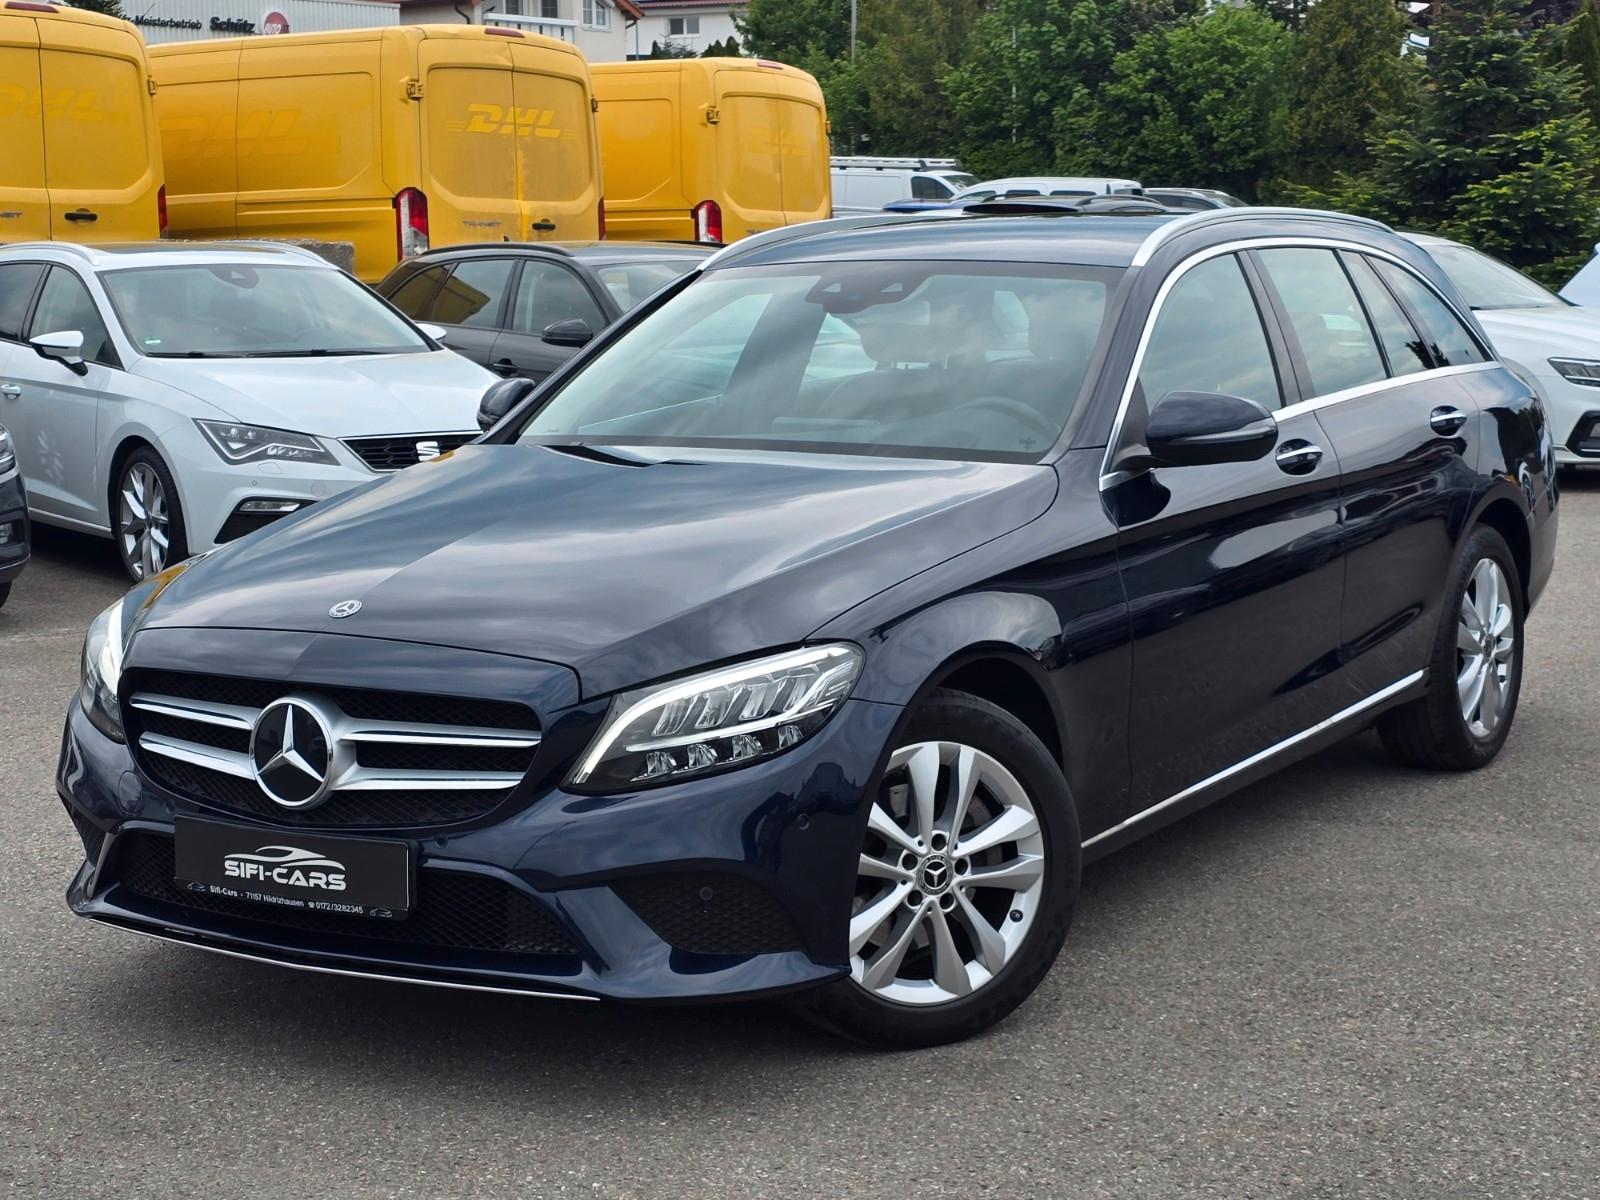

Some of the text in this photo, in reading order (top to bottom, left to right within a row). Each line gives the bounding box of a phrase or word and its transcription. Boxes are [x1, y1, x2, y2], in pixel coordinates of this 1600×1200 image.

[466, 103, 561, 138] DHL
[223, 859, 347, 891] SIFI-CARS
[209, 885, 238, 897] Sifi-Cars
[245, 891, 262, 901] 71157
